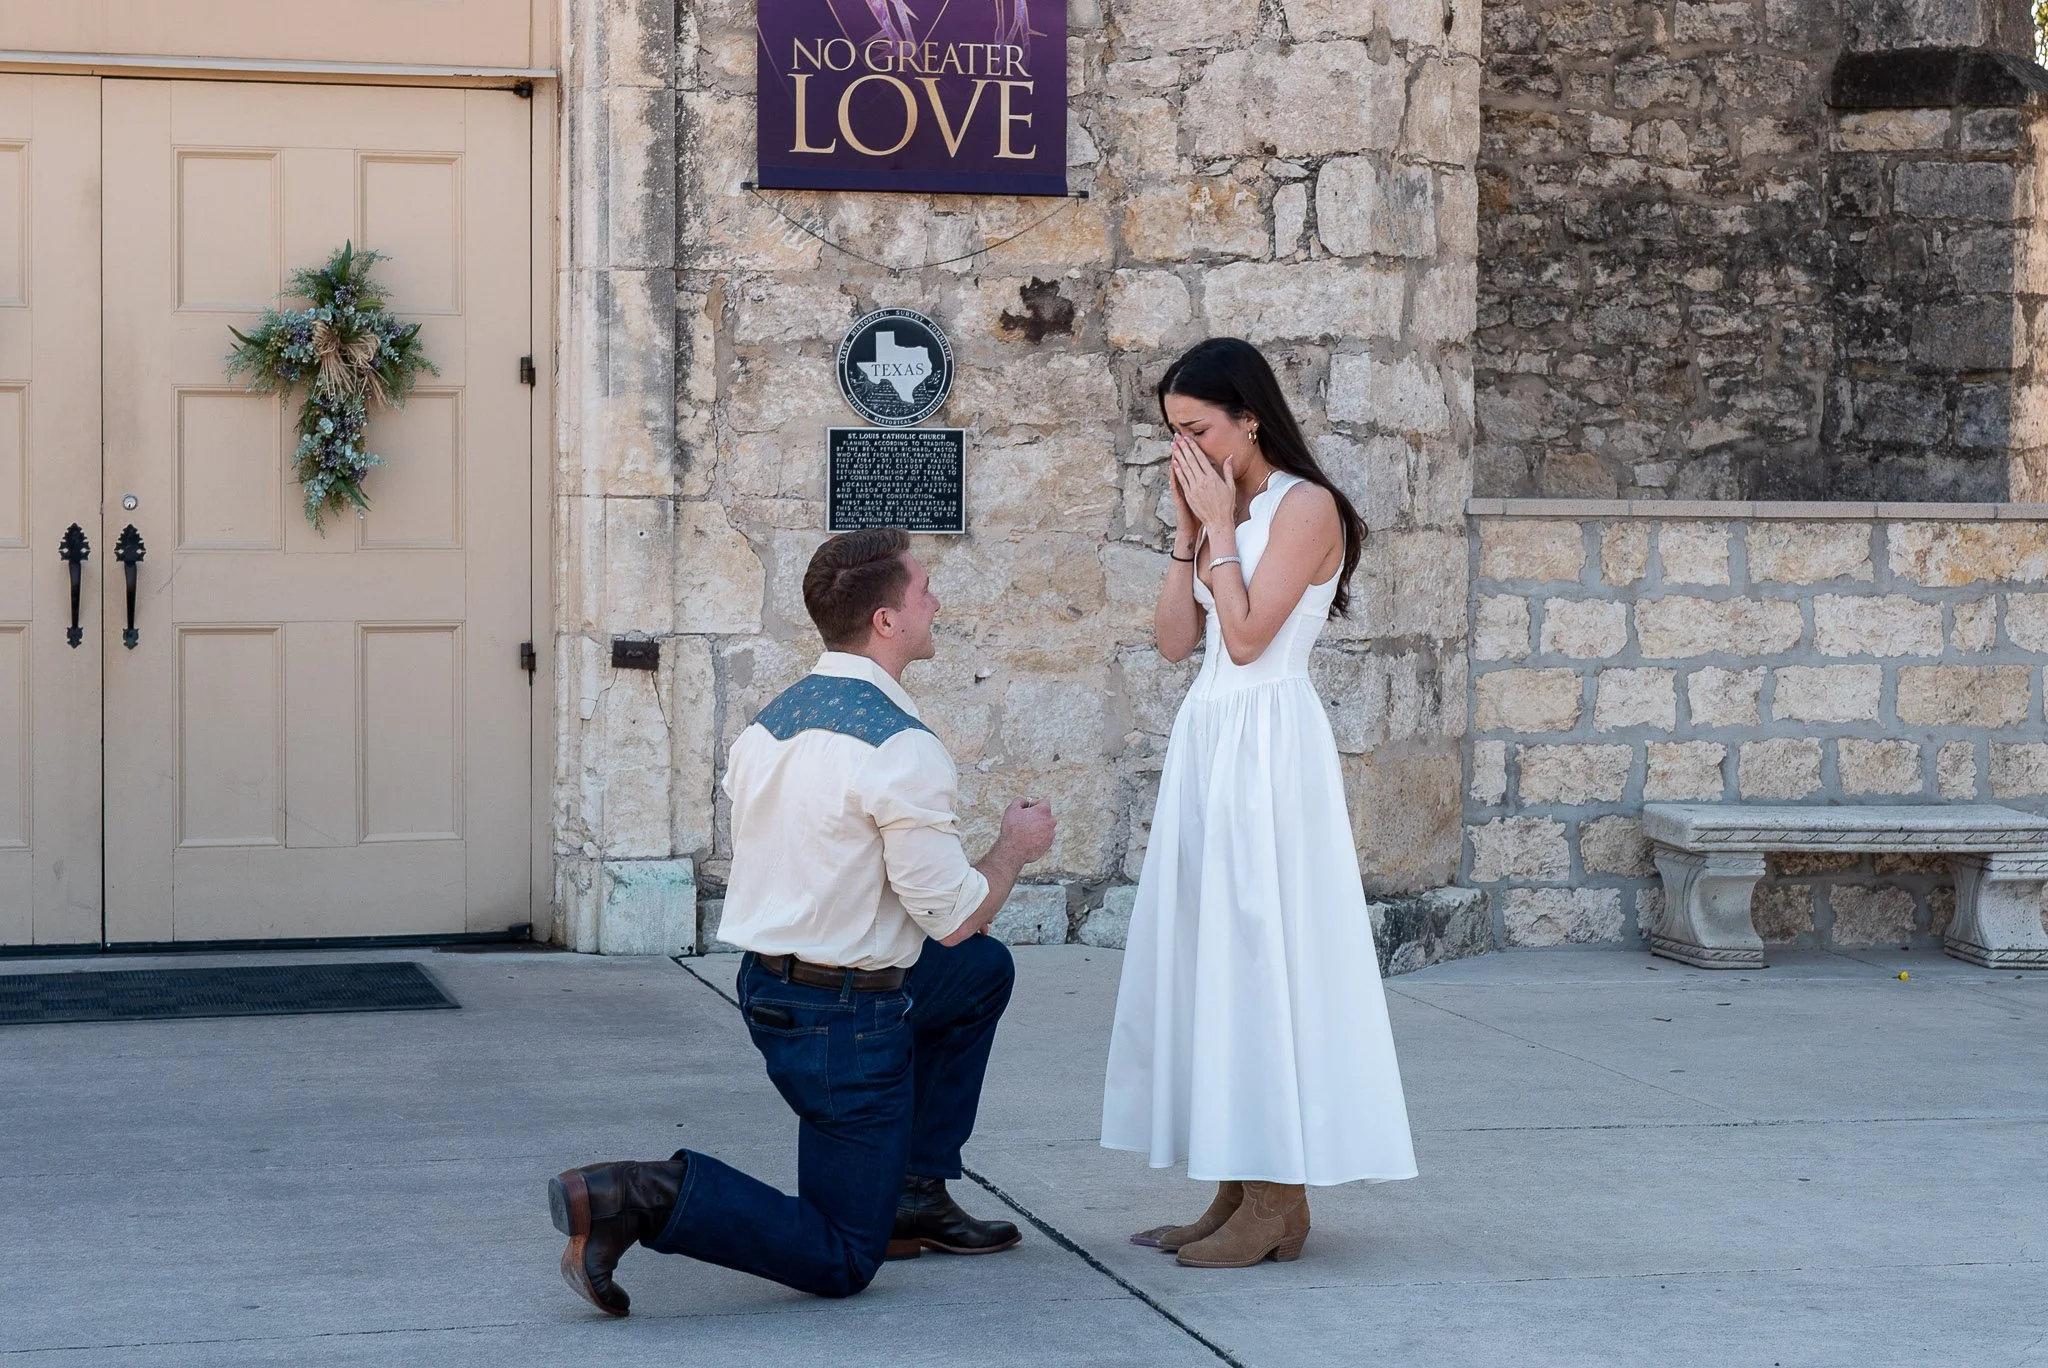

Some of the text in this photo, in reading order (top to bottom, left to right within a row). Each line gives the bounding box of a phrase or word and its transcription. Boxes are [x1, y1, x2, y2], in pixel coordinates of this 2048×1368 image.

[792, 38, 1032, 77] NO GREATER
[787, 73, 1037, 160] LOVE
[839, 308, 952, 364] STATE HISTORICAL SURVEY COMMITTEE
[871, 363, 925, 377] TEXAS
[847, 393, 945, 425] OFFICIAL HISTORICAL MEDALLION
